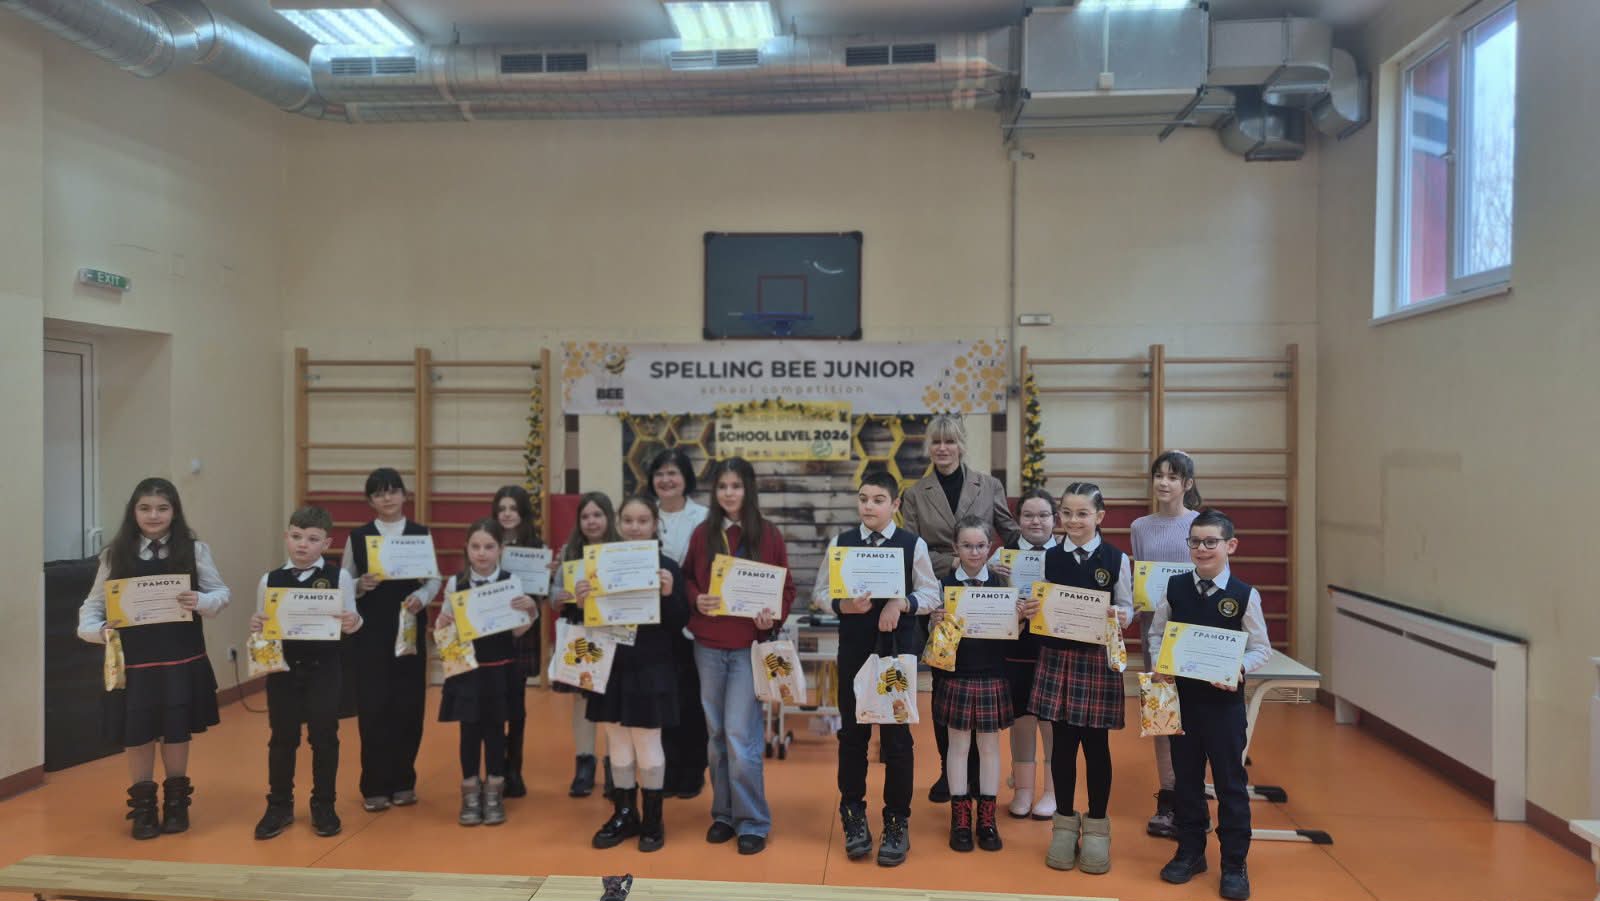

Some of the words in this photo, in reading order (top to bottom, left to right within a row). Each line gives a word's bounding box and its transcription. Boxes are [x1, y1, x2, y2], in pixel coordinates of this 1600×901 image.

[97, 271, 121, 286] EXIT
[650, 361, 763, 379] SPELLING
[771, 361, 816, 378] BEE
[824, 361, 914, 378] JUNIOR
[596, 388, 624, 400] BEE
[701, 384, 753, 394] school
[762, 384, 864, 396] competition
[719, 431, 771, 442] SCHOOL
[775, 430, 811, 441] LEVEL
[814, 430, 849, 440] 2026
[737, 570, 776, 579] ГРАМОТА
[137, 580, 181, 588] ГРАМОТА
[1059, 591, 1101, 603] ГРАМОТА
[1193, 631, 1236, 643] ГРАМОТА
